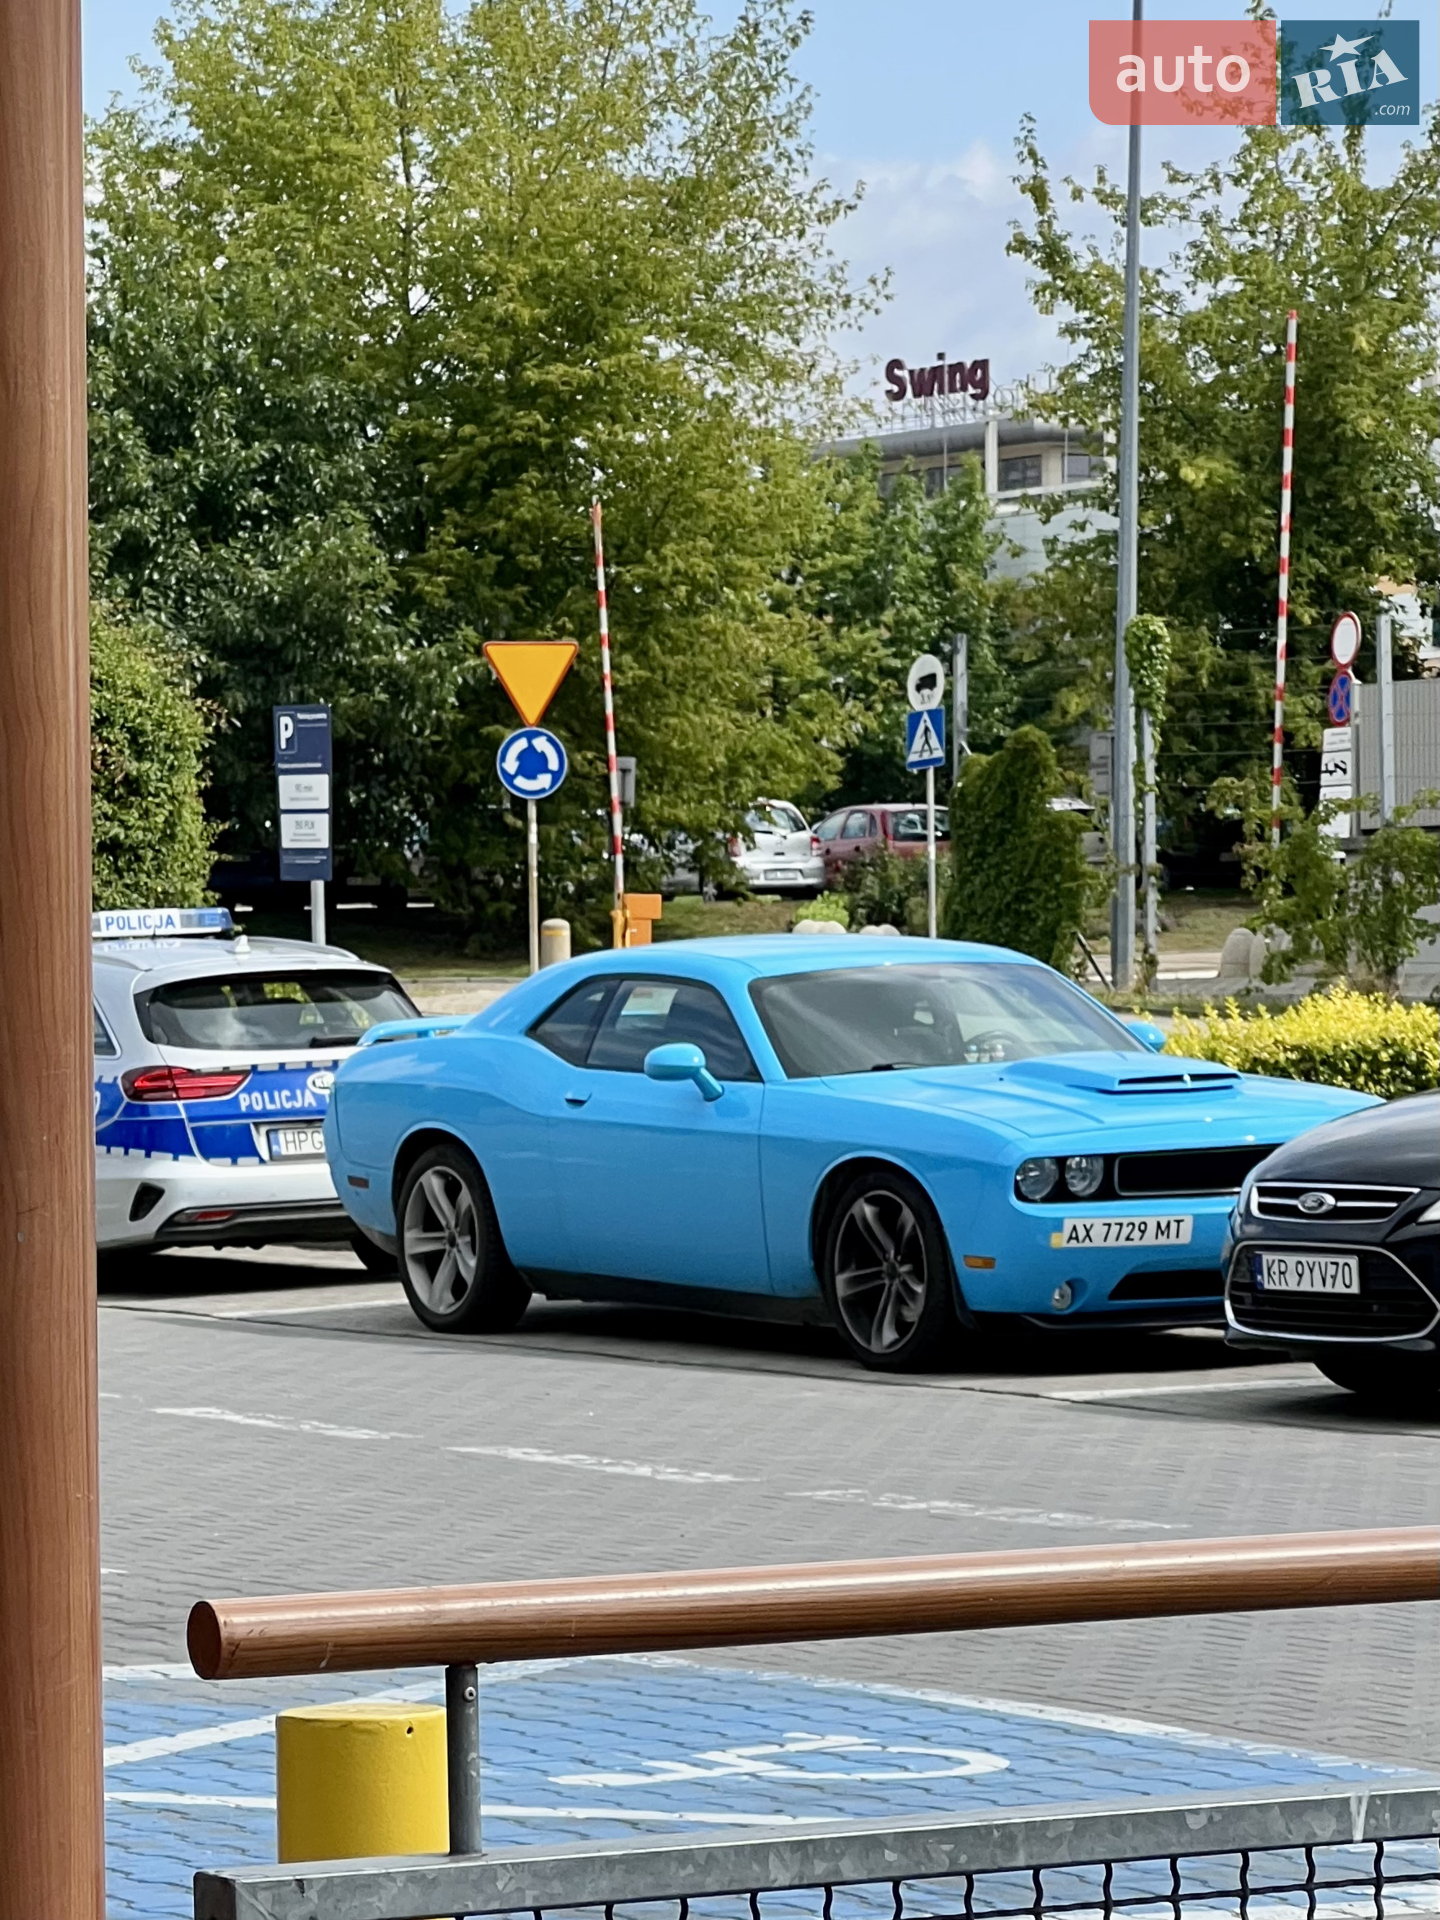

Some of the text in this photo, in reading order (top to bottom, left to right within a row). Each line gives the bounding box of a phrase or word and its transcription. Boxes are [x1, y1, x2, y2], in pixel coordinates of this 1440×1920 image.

[885, 352, 990, 401] Swing
[280, 716, 294, 750] P
[105, 914, 176, 931] POLICJA
[238, 1088, 317, 1112] POLICJA
[1066, 1219, 1185, 1244] AX 7729 MT
[1266, 1258, 1289, 1287] KR
[1295, 1260, 1353, 1289] 9YV70
